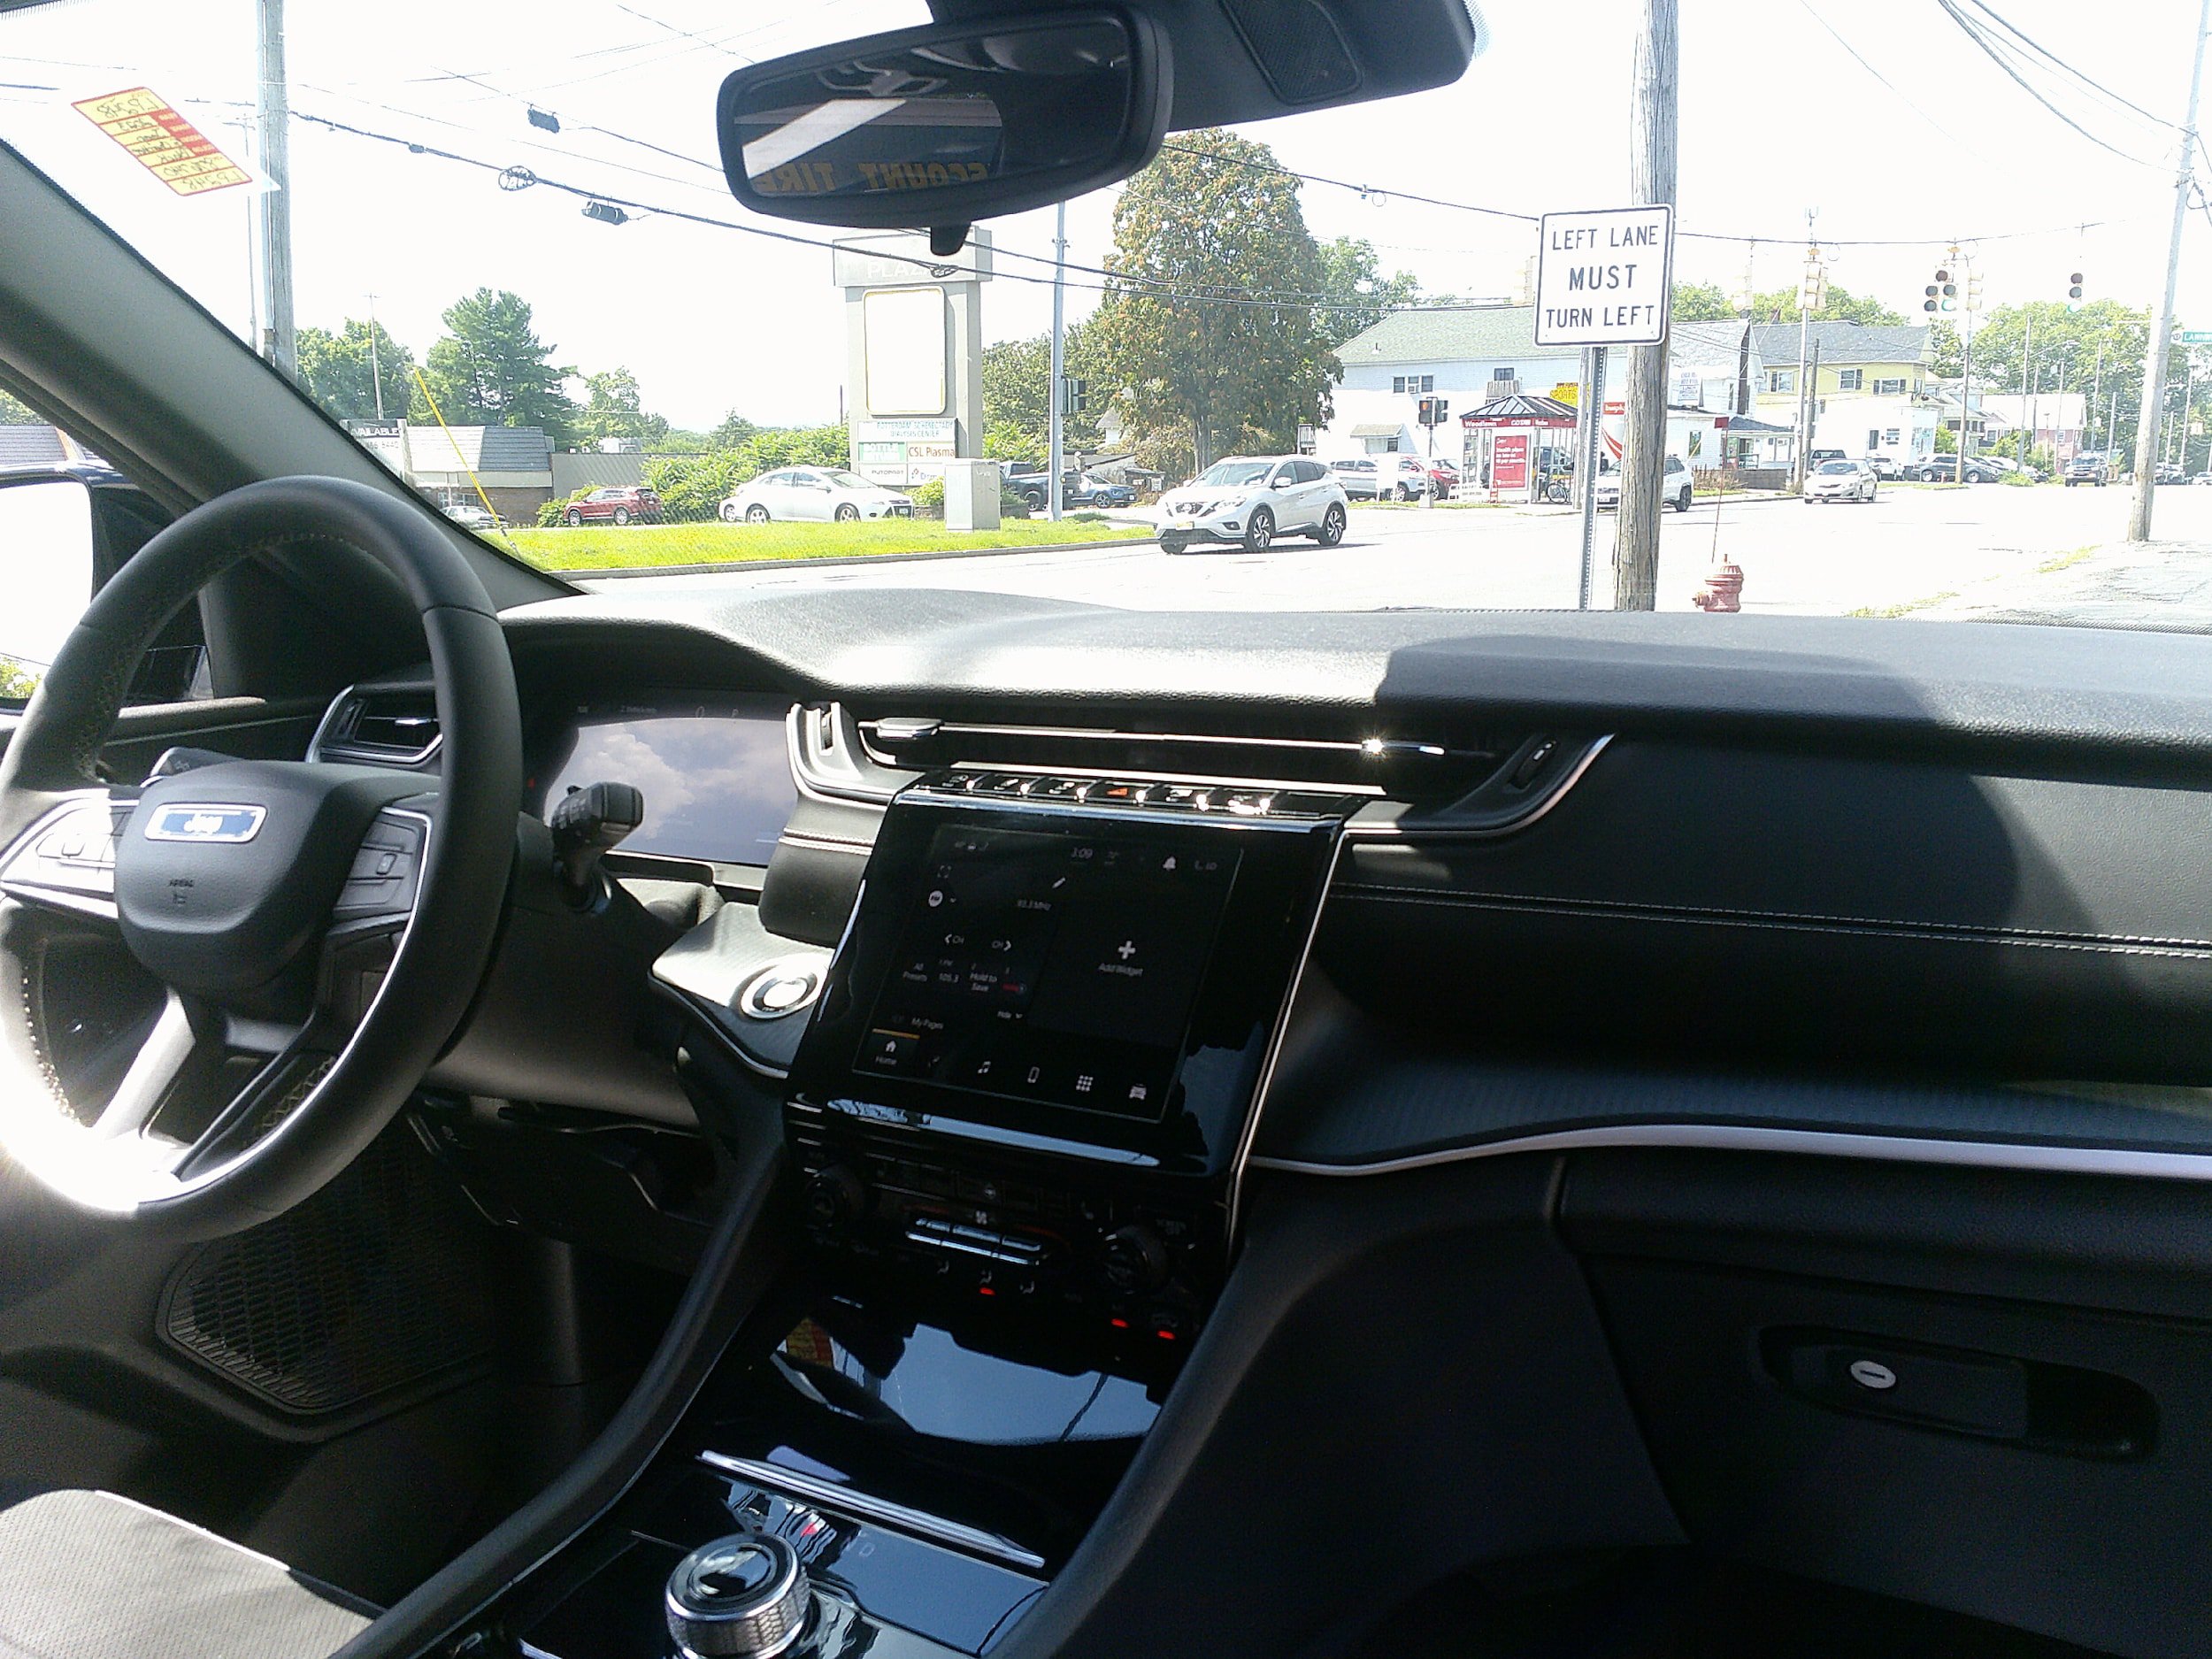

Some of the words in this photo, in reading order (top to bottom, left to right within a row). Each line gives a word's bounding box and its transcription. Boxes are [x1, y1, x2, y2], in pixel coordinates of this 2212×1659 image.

[1552, 228, 1598, 250] LEFT
[1609, 226, 1659, 248] LANE
[1569, 265, 1638, 291] MUST
[1546, 308, 1593, 328] TURN
[1603, 305, 1655, 326] LEFT
[908, 446, 924, 457] CSL
[926, 446, 956, 457] Plasma
